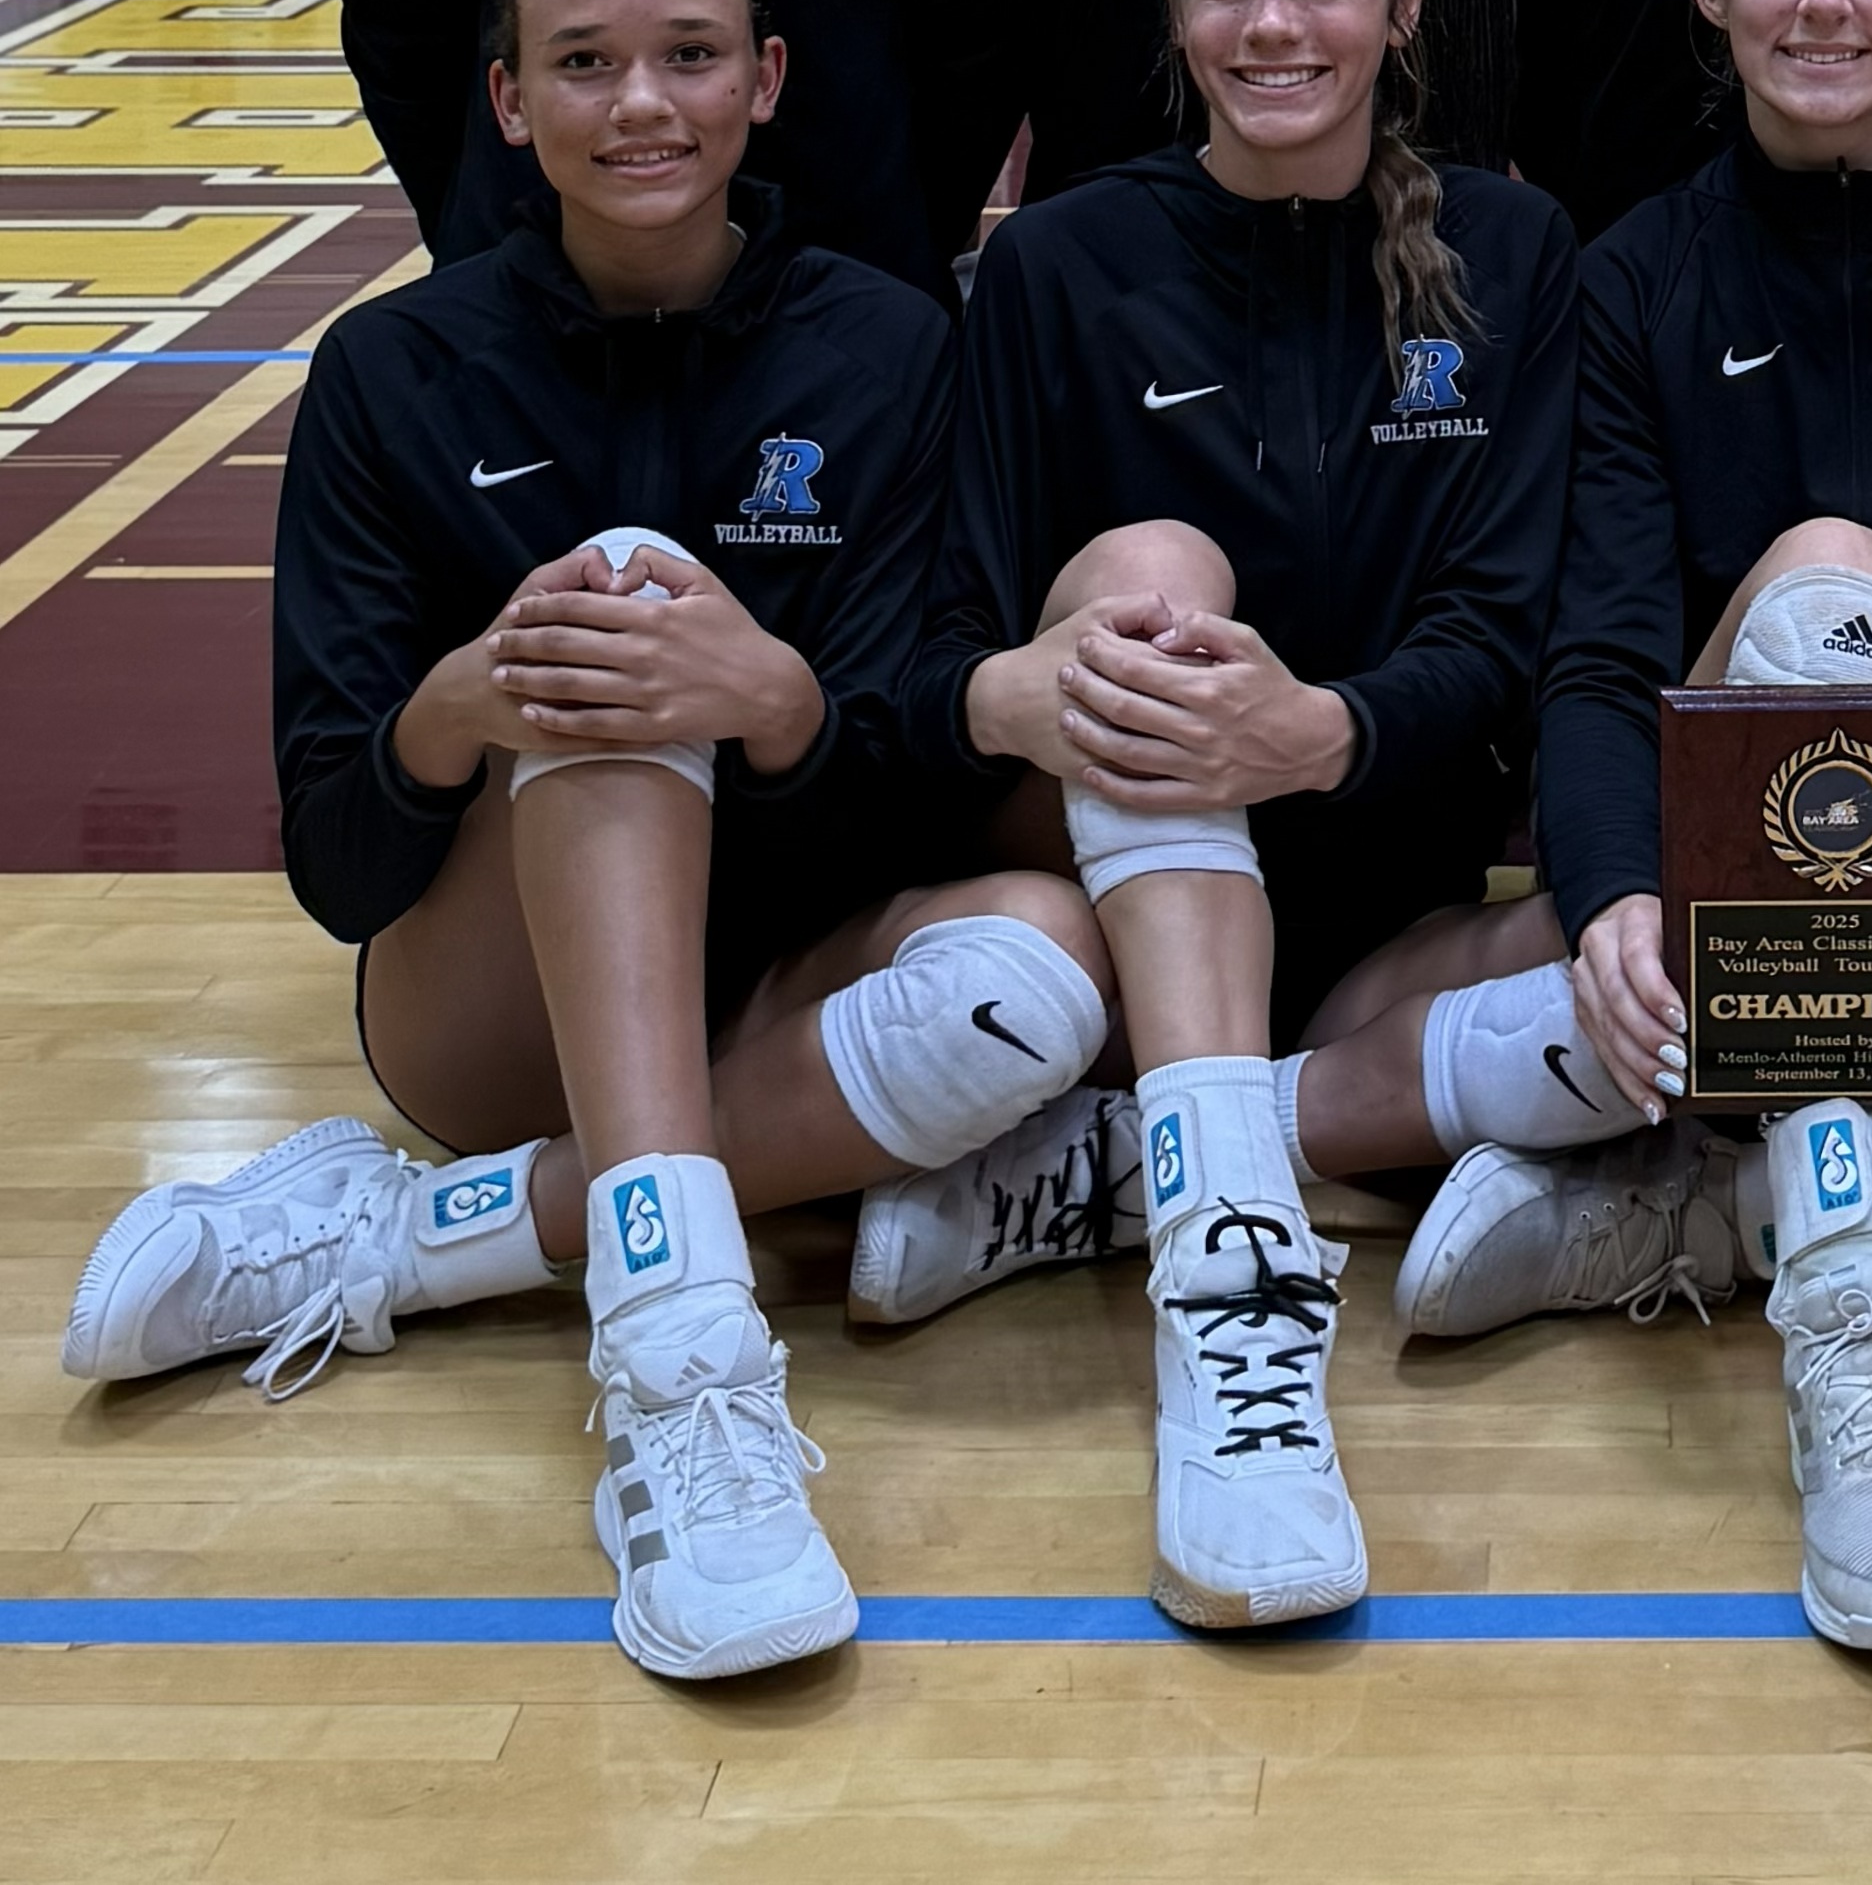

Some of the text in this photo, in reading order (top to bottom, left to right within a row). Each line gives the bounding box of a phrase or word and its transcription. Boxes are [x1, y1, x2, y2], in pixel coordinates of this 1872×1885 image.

[1391, 334, 1467, 420] R
[1370, 417, 1489, 445] VOLLEYBALL
[740, 432, 824, 522] R
[714, 523, 843, 545] VOLLEYBALL
[1810, 914, 1860, 929] 2025
[1708, 936, 1748, 954] Bay
[1755, 936, 1804, 952] Area
[1718, 958, 1819, 976] Volleyball
[1794, 1034, 1851, 1047] Hosted
[1717, 1051, 1846, 1064] Menlo-Atherton
[1754, 1067, 1839, 1082] September
[1848, 1067, 1871, 1081] 13,
